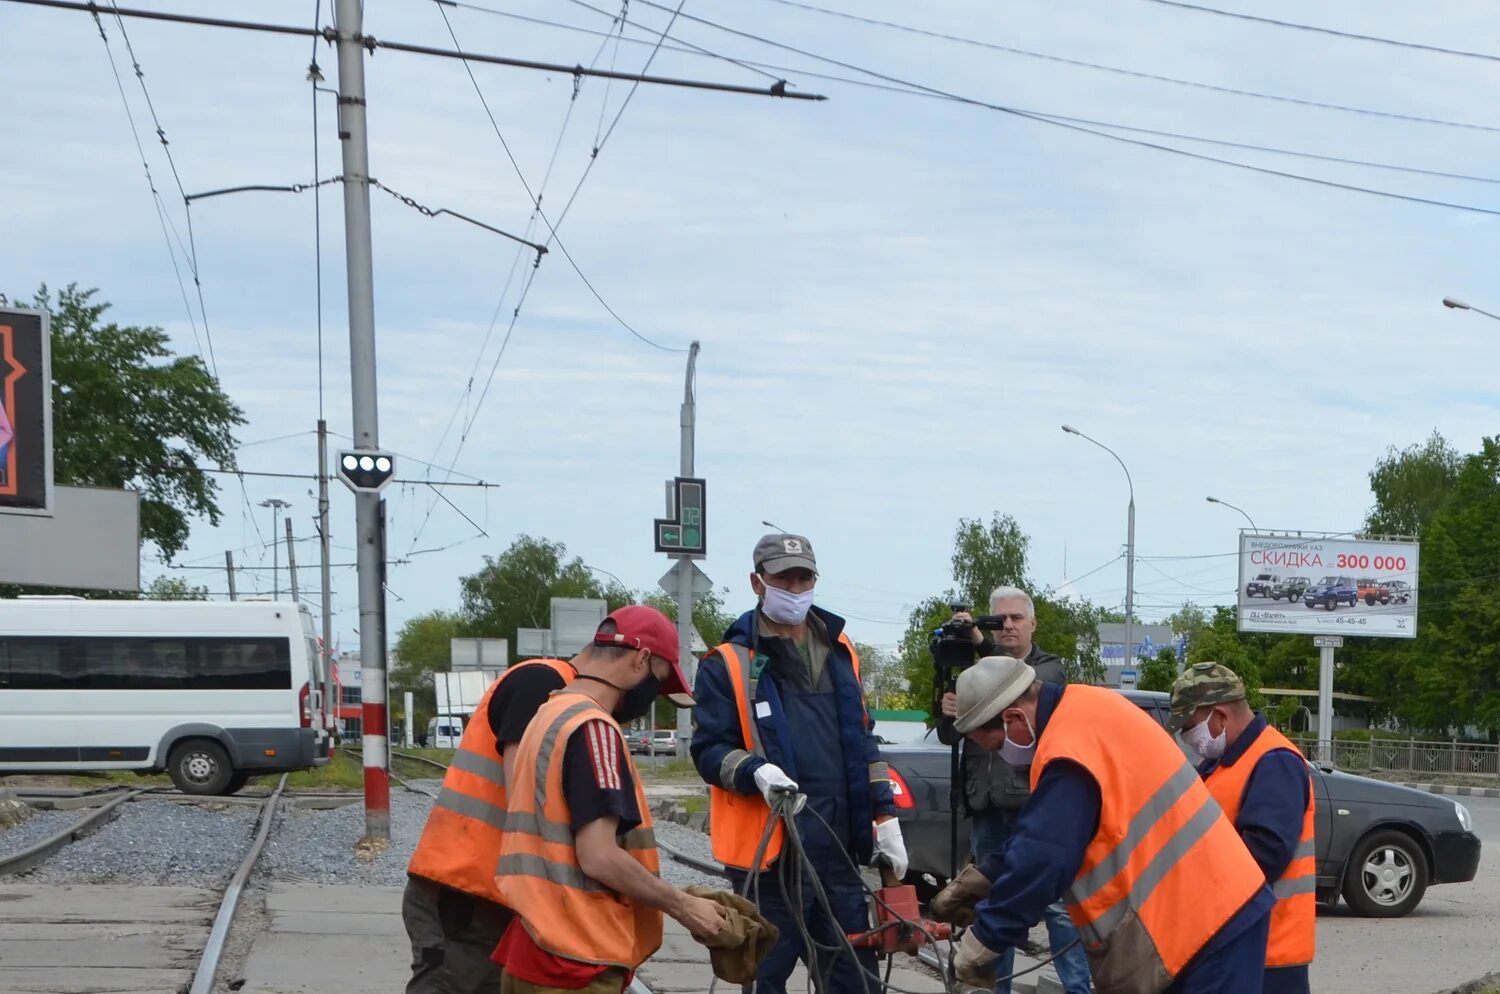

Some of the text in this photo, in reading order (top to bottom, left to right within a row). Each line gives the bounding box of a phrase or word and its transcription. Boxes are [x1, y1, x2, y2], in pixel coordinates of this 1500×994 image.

[1251, 551, 1322, 568] СКИДКА
[1336, 554, 1369, 569] 300
[1373, 555, 1406, 571] 000
[1335, 617, 1367, 625] 45-45-45
